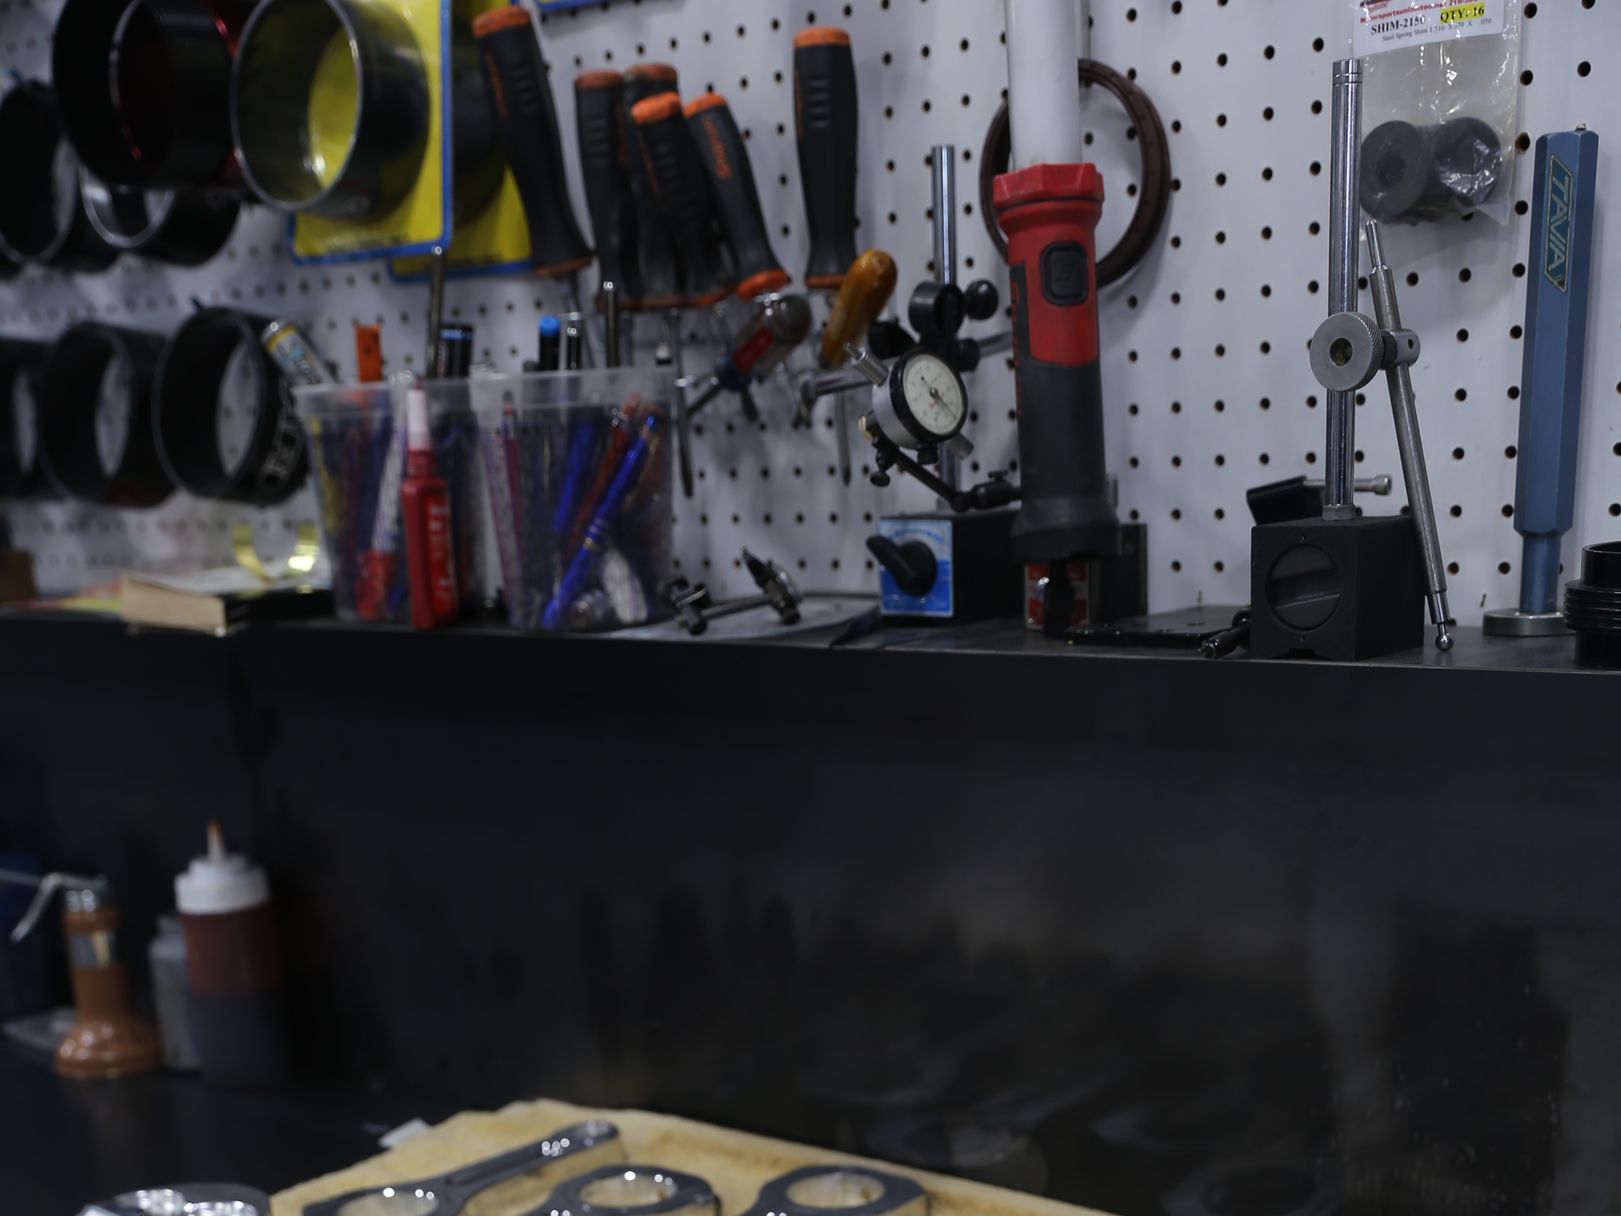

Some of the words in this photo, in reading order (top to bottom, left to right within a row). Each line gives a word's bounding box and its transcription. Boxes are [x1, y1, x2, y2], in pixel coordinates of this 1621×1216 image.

[1440, 9, 1469, 23] QTY:
[1473, 6, 1485, 16] 16
[1548, 175, 1569, 272] TAVIA
